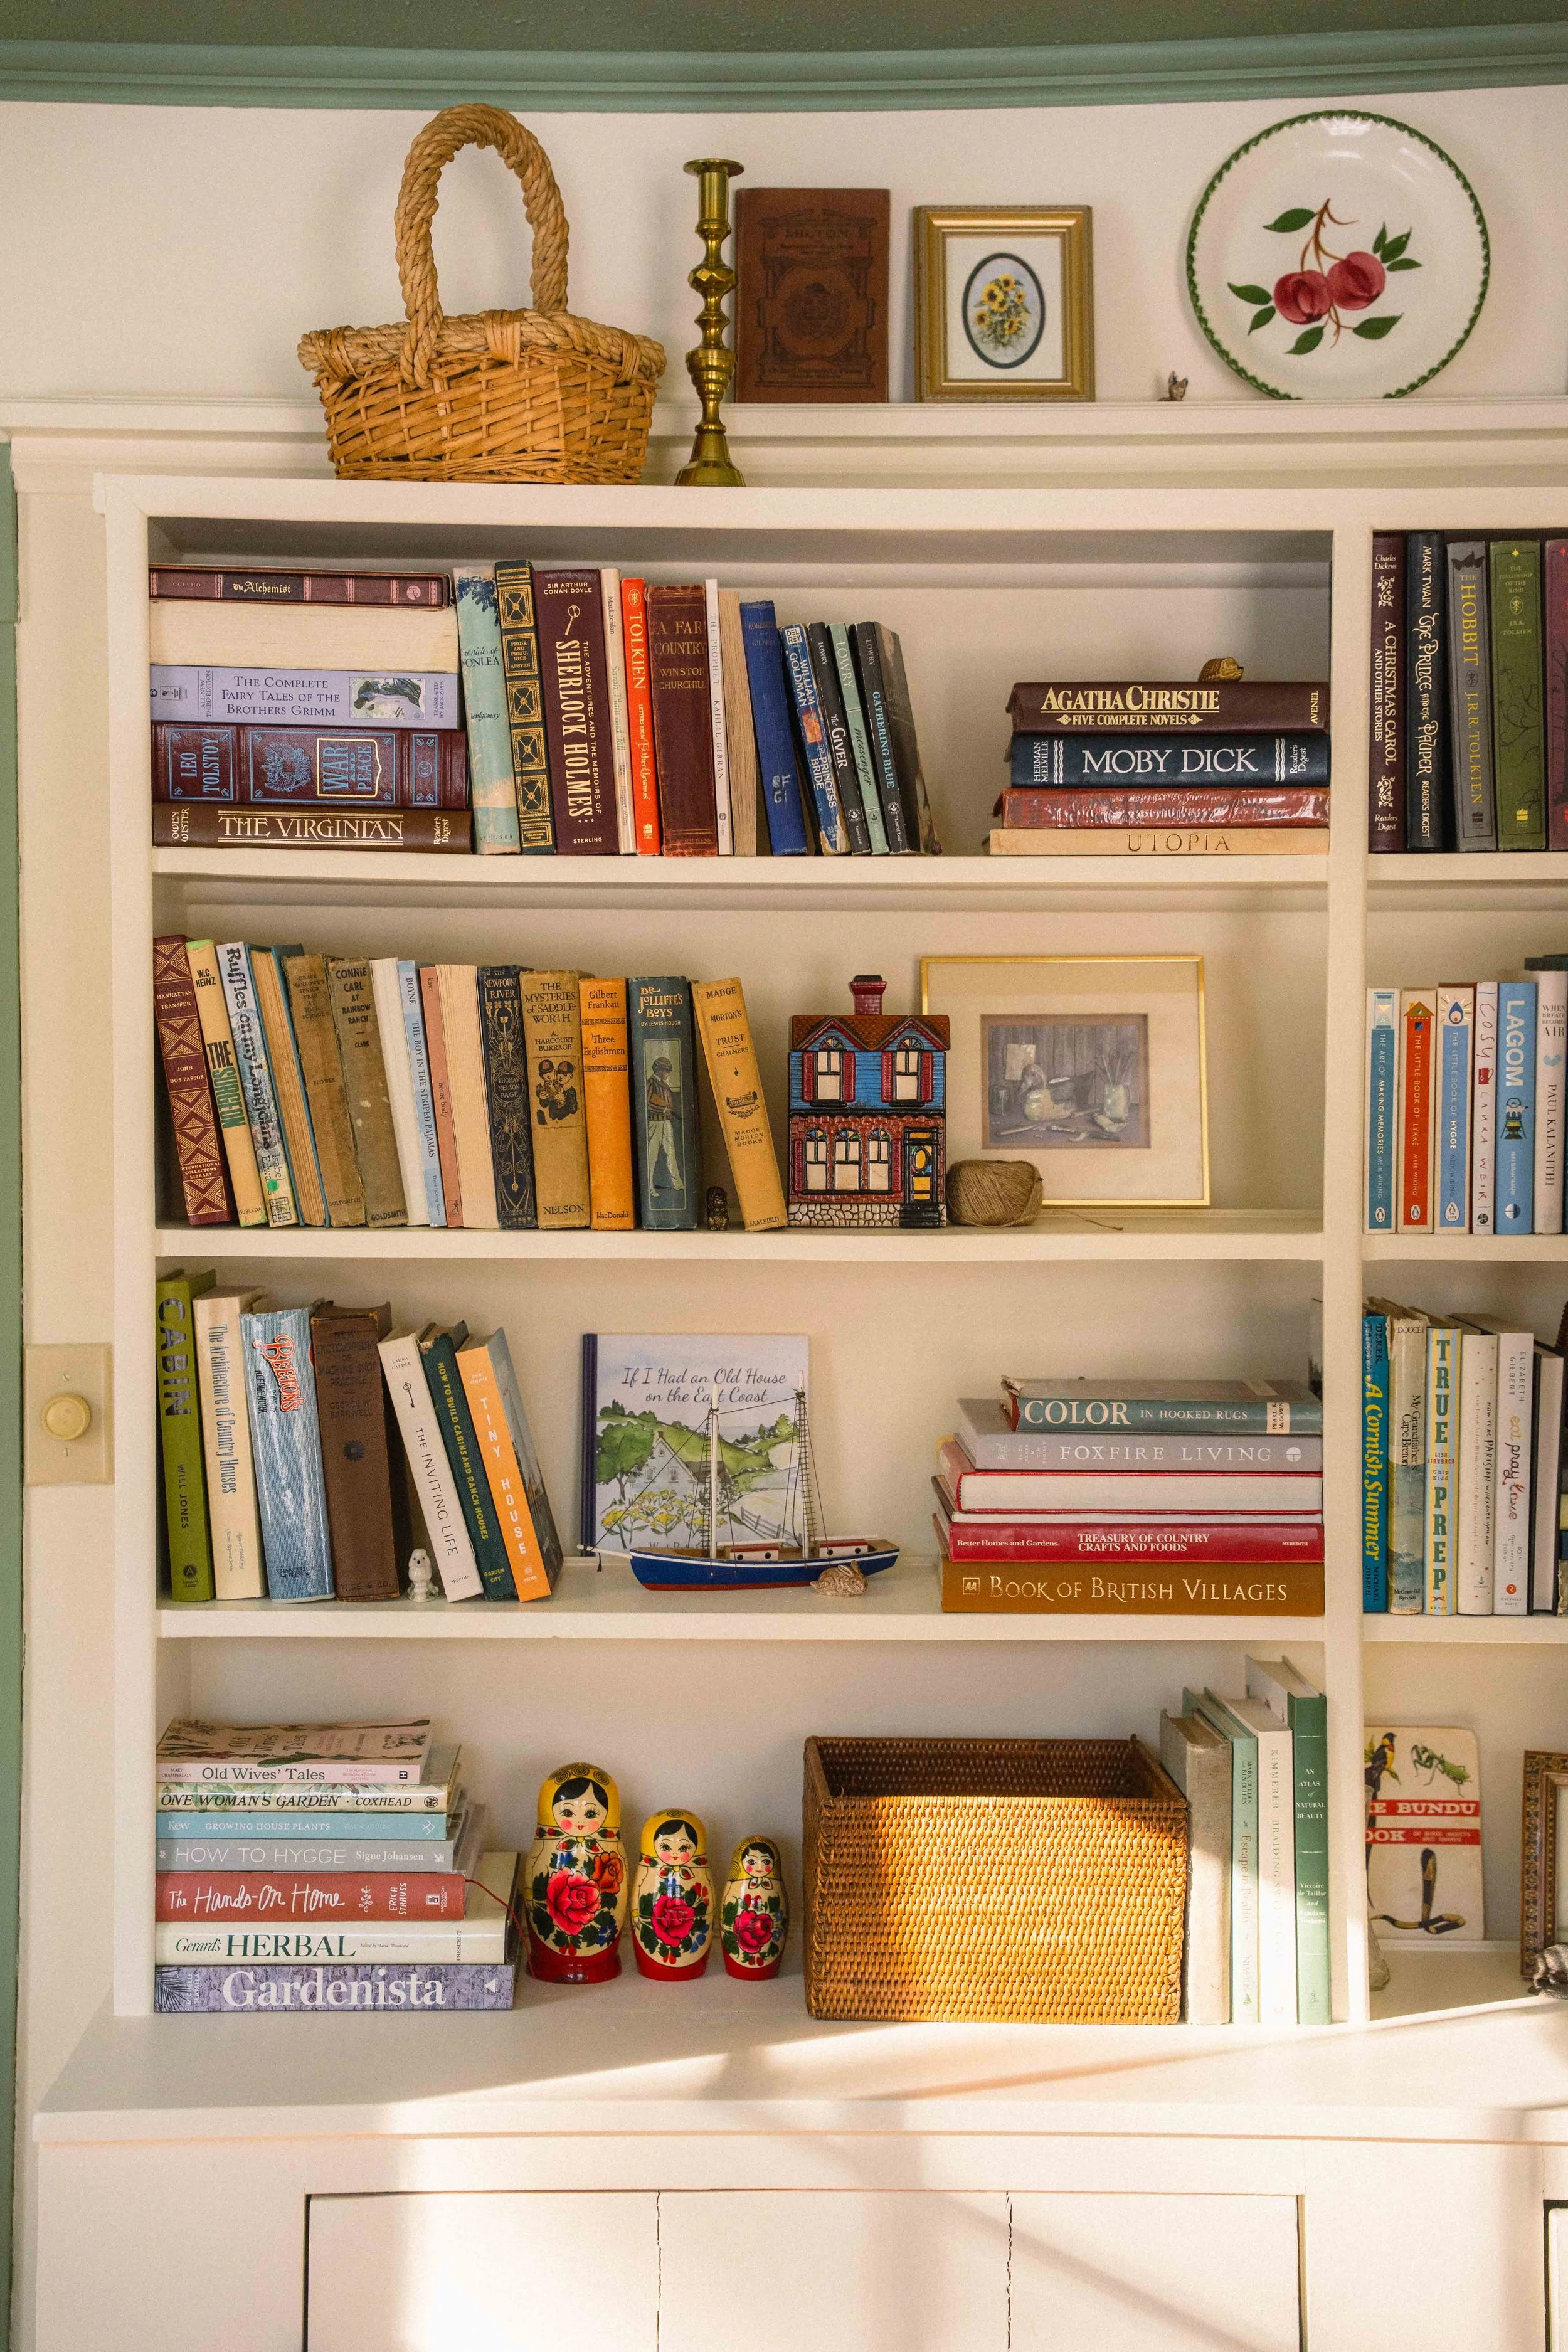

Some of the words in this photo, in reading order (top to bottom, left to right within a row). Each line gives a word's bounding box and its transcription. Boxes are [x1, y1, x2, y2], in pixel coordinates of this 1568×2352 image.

[1375, 562, 1396, 570] Dickens
[1376, 554, 1396, 563] Charles
[1423, 546, 1432, 571] MARK
[233, 583, 244, 592] The
[244, 581, 291, 594] Alchemist
[1422, 575, 1431, 607] TWAIN
[658, 623, 667, 634] A
[675, 622, 703, 633] FAR
[1385, 621, 1396, 632] A
[1461, 583, 1478, 666] HOBBIT
[629, 612, 646, 689] TOLKIEN
[655, 642, 706, 655] COUNTRY
[835, 642, 854, 688] LOWRY
[1384, 636, 1396, 717] CHRISTMAS
[234, 676, 259, 688] THE
[265, 677, 328, 689] COMPLETE
[556, 640, 587, 737] SHERLOCK
[790, 652, 807, 706] GOLDMAN
[800, 660, 815, 705] WILLIAM
[221, 689, 255, 701] FAIRY
[259, 690, 294, 702] TALES
[298, 692, 313, 702] OF
[317, 692, 340, 702] THE
[1041, 687, 1125, 710] AGATHA
[1126, 686, 1219, 711] CHRISTIE
[1310, 691, 1318, 724] AVENEL
[227, 703, 286, 715] BROTHERS
[291, 704, 335, 717] GRIMM
[830, 714, 839, 725] The
[1073, 715, 1094, 725] FIVE
[1097, 714, 1147, 726] COMPLETE
[1150, 714, 1187, 726] NOVELS
[832, 728, 847, 769] GIVER
[873, 692, 889, 755] GATHERING
[884, 759, 894, 788] BLUE
[1385, 719, 1397, 766] CAROL
[181, 752, 197, 777] LEO
[203, 738, 220, 793] TOLSTOY
[322, 746, 349, 792] WAR
[358, 746, 372, 791] PEACE
[854, 728, 872, 787] messenger
[1083, 750, 1175, 774] MOBY
[1182, 749, 1259, 773] DICK
[811, 758, 824, 789] BRIDE
[820, 756, 837, 808] PRINCESS
[171, 812, 179, 839] OWEN
[181, 808, 189, 842] WISTER
[218, 817, 270, 837] THE
[275, 817, 403, 839] VIRGINIAN
[1128, 834, 1231, 852] UTOPIA
[196, 976, 216, 988] HEINZ
[541, 982, 561, 990] THE
[706, 987, 737, 1000] MADGE
[157, 990, 192, 999] MANHATTAN
[161, 1001, 191, 1010] TRANSFER
[525, 992, 576, 1002] MYSTERIES
[588, 1000, 619, 1009] Frankau
[589, 990, 618, 1000] Gilbert
[527, 1003, 536, 1013] of
[533, 1013, 571, 1024] WORTH
[591, 1035, 615, 1044] Three
[716, 1034, 744, 1046] TRUST
[1506, 1000, 1525, 1086] LAGOM
[207, 1041, 233, 1069] THE
[583, 1046, 625, 1059] Englishmen
[184, 1074, 204, 1083] PASSOS
[212, 1067, 245, 1129] SURGEON
[1548, 1084, 1557, 1114] PAUL
[1545, 1118, 1557, 1186] KALANITHI
[543, 1204, 584, 1216] NELSON
[209, 1324, 228, 1343] The
[158, 1298, 191, 1417] CABIN
[209, 1346, 230, 1406] Architecture
[622, 1367, 640, 1388] If
[642, 1368, 653, 1384] I
[658, 1368, 687, 1384] Had
[691, 1374, 709, 1384] an
[714, 1368, 742, 1384] Old
[746, 1368, 786, 1384] House
[645, 1392, 662, 1402] on
[667, 1387, 689, 1402] the
[694, 1387, 724, 1402] Eat
[729, 1389, 768, 1402] Coast
[1436, 1339, 1450, 1444] TRUE
[216, 1407, 235, 1417] of
[1024, 1401, 1131, 1425] COLOR
[1140, 1410, 1153, 1419] IN
[1160, 1410, 1210, 1419] HOOKED
[1216, 1410, 1248, 1420] RUGS
[216, 1420, 236, 1456] Country
[480, 1398, 501, 1458] TINY
[1060, 1446, 1165, 1461] FOXFIRE
[1182, 1448, 1272, 1461] LIVING
[177, 1464, 186, 1488] WILL
[220, 1459, 238, 1494] Houses
[416, 1428, 428, 1449] THE
[422, 1453, 448, 1519] INVITING
[441, 1525, 458, 1555] LIFE
[180, 1493, 189, 1529] JONES
[501, 1479, 526, 1554] HOUSE
[1078, 1534, 1135, 1543] TREASURY
[1138, 1534, 1153, 1543] OF
[1156, 1534, 1209, 1543] COUNTRY
[1078, 1543, 1121, 1552] CRAFTS
[1123, 1543, 1147, 1552] AND
[1150, 1542, 1187, 1552] FOODS
[1433, 1487, 1447, 1590] PREP
[990, 1576, 1052, 1602] BOOK
[1057, 1582, 1082, 1598] OF
[1091, 1577, 1173, 1603] BRITISH
[1182, 1579, 1287, 1601] VILLAGES
[202, 1767, 228, 1780] Old
[287, 1767, 326, 1781] Tales
[161, 1794, 193, 1806] ONE
[276, 1794, 342, 1807] GARDEN
[356, 1797, 412, 1806] COXHEAD
[1397, 1803, 1476, 1815] BUNDU
[205, 1823, 254, 1831] GROWING
[293, 1823, 331, 1831] PLANTS
[176, 1847, 228, 1863] HOW
[237, 1848, 266, 1863] TO
[274, 1848, 346, 1863] HYGGE
[356, 1851, 381, 1862] Signe
[383, 1851, 424, 1863] Johansen
[169, 1890, 187, 1909] The
[194, 1885, 286, 1914] Hands-On
[291, 1884, 345, 1914] Home
[176, 1938, 222, 1954] Gerard's
[225, 1934, 356, 1957] HERBAL
[223, 1968, 447, 2007] Gardenista
